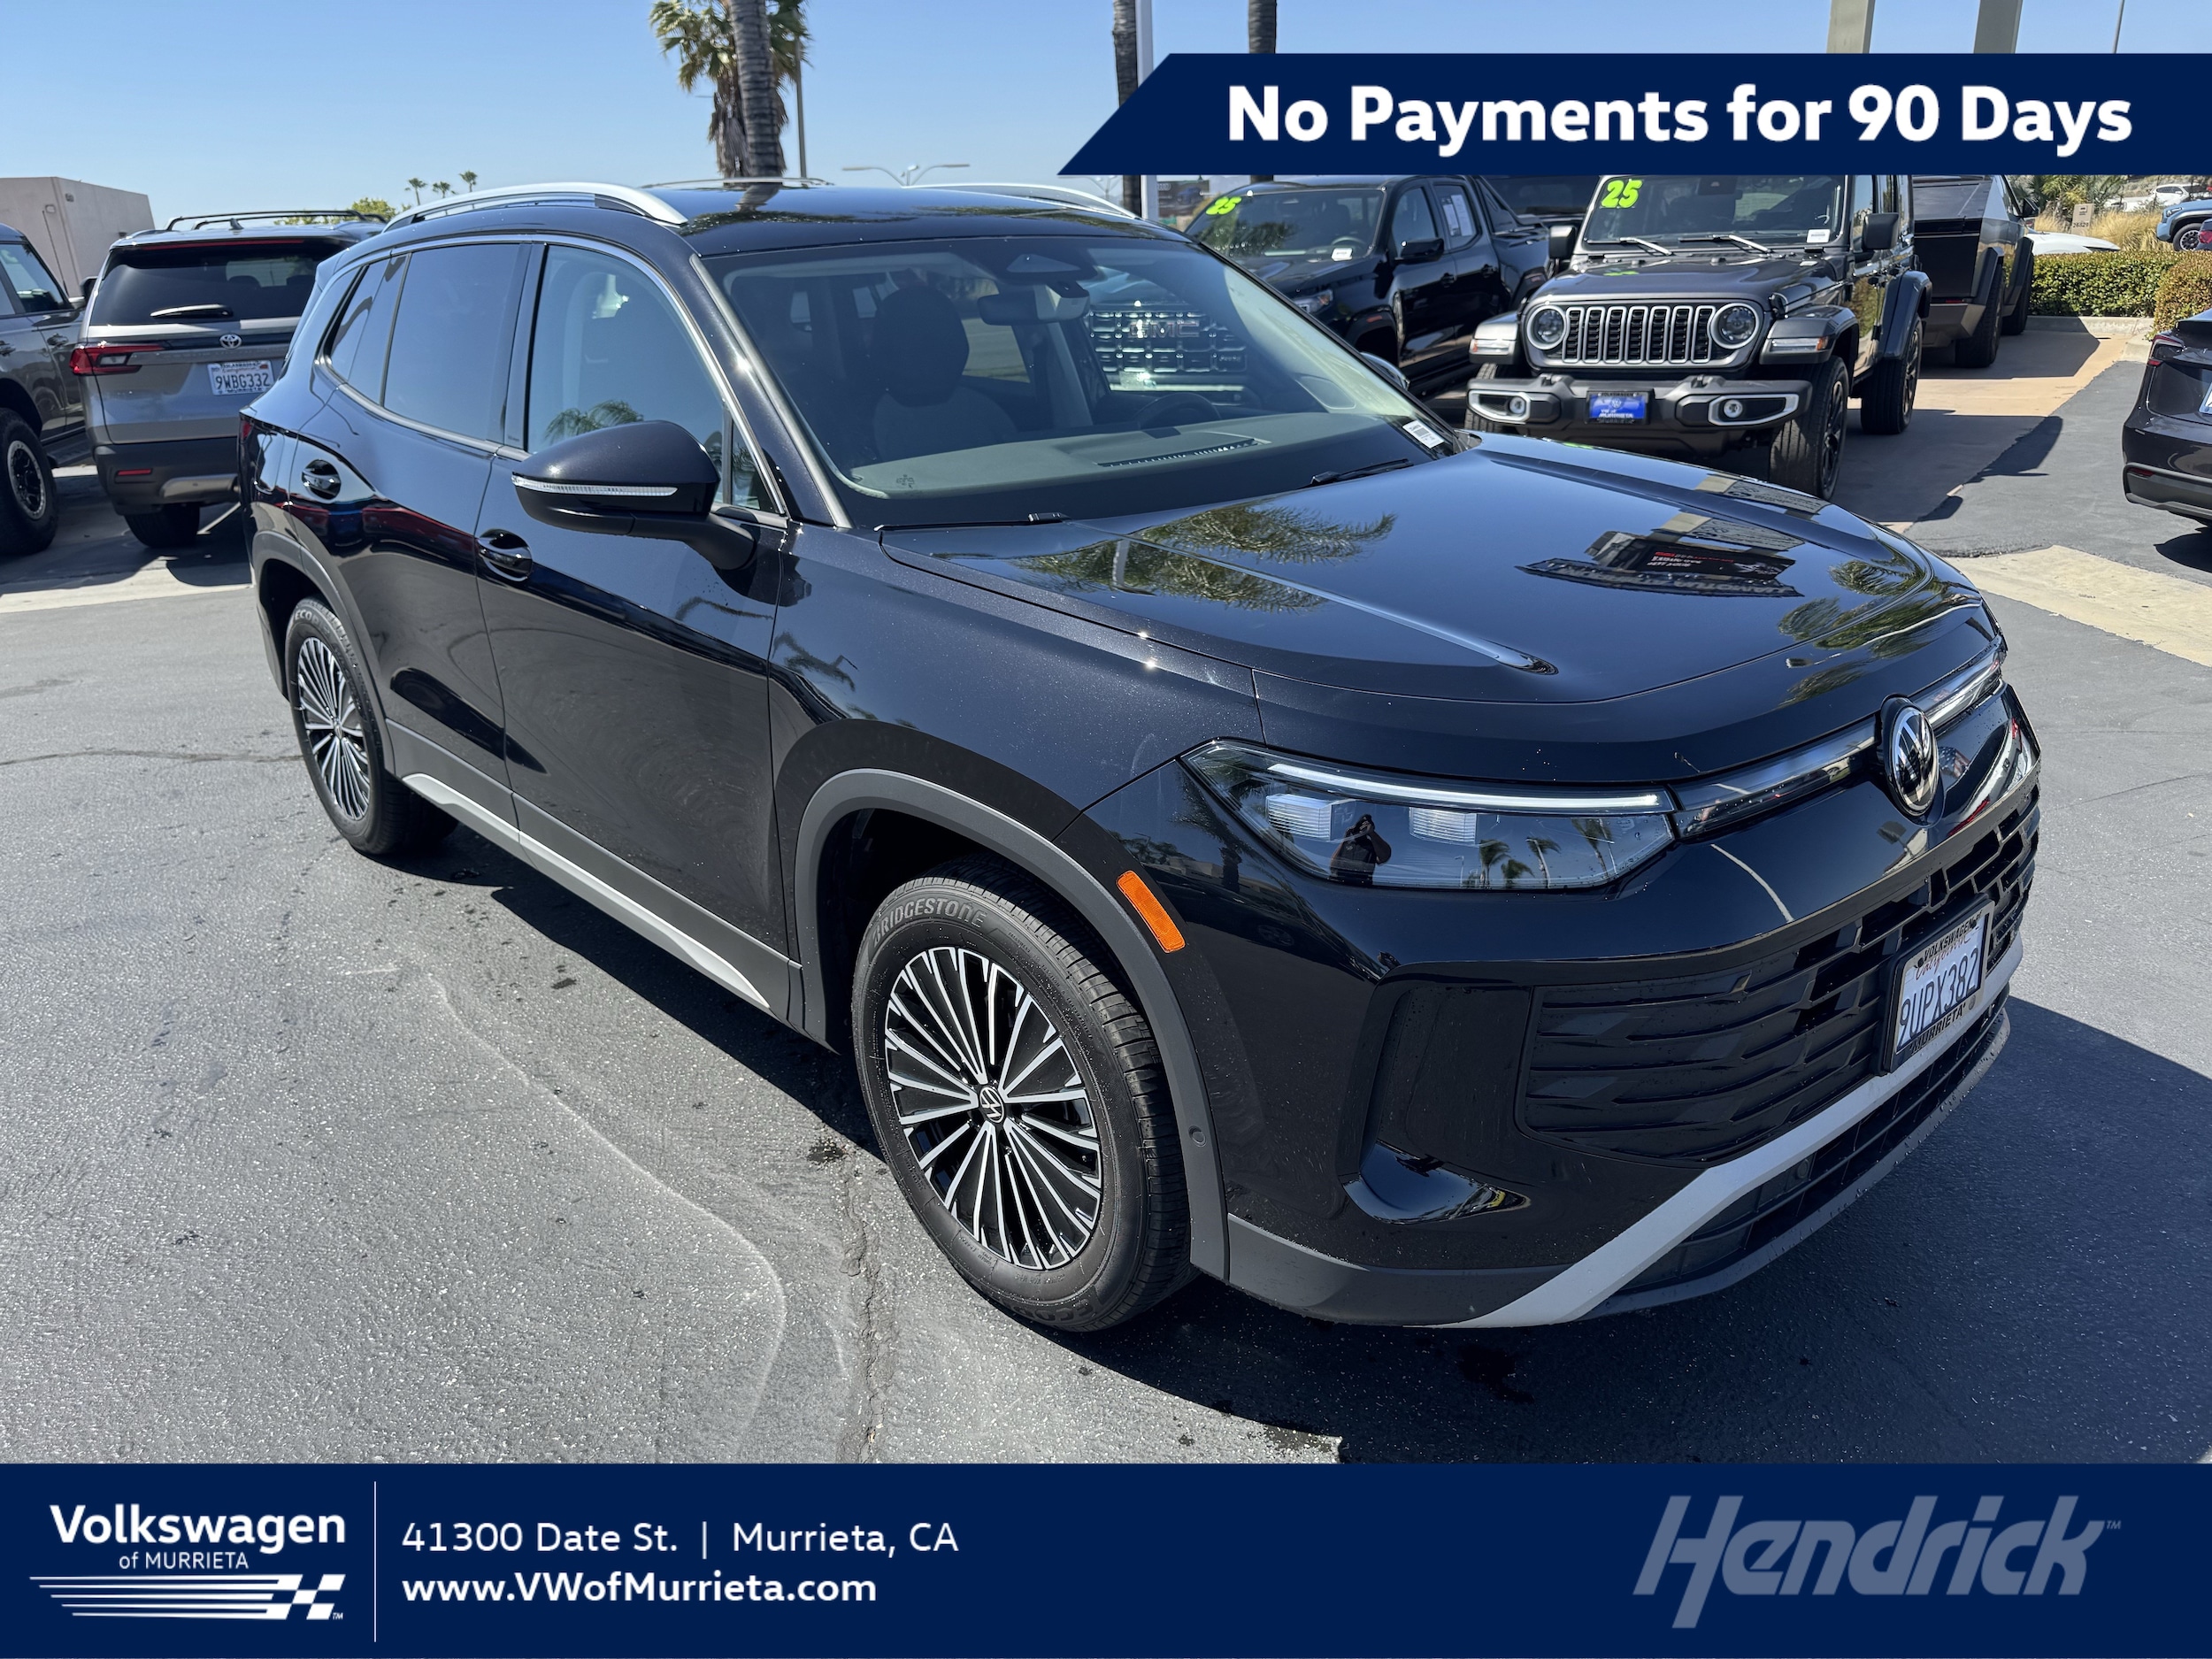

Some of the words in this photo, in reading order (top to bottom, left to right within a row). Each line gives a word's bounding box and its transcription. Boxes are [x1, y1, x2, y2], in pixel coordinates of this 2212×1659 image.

[1205, 196, 1242, 215] 25
[1601, 179, 1643, 209] 25
[215, 372, 271, 390] 9WBG332
[872, 897, 987, 946] BRIDGESTONE
[1924, 918, 1975, 960] VOLKSWAGEN
[1897, 947, 1979, 1049] 9UPX382
[1911, 1007, 1963, 1054] MURRIETA
